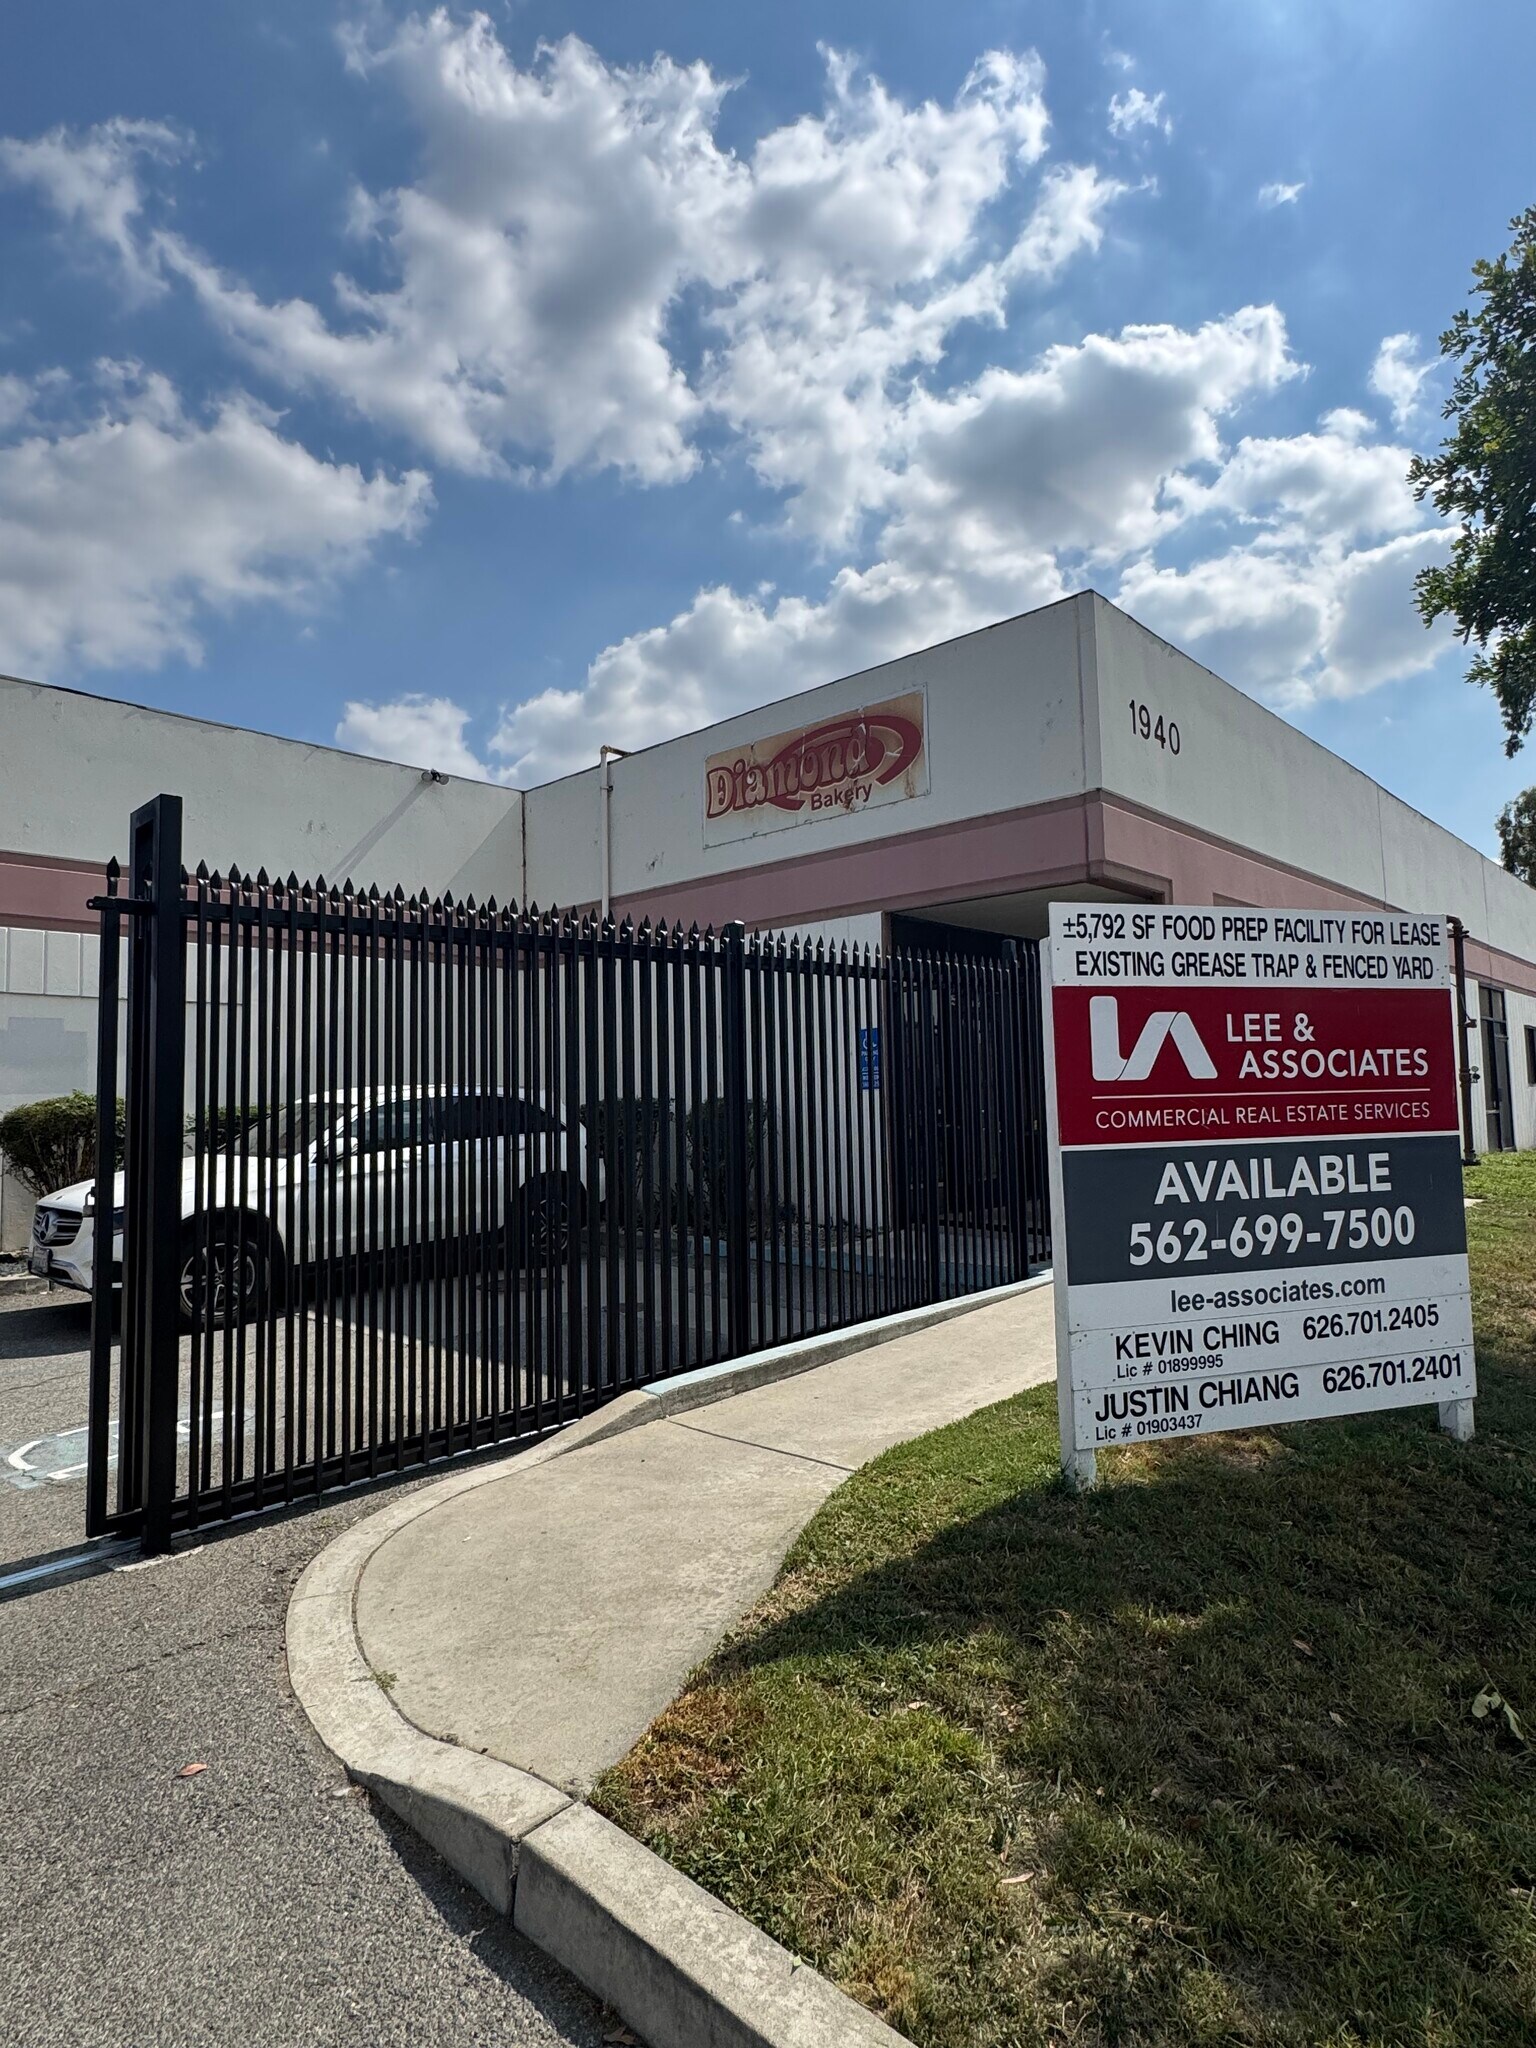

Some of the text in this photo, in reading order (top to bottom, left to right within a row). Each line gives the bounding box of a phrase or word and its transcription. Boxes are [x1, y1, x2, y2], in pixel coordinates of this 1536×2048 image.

[1129, 699, 1180, 755] 1940
[707, 723, 871, 818] Diamond
[811, 783, 872, 811] Bakery
[1063, 913, 1441, 946] ±5,792 SF FOOD PREP FACILITY FOR LEASE
[1075, 950, 1433, 980] EXISTING GREASE TRAP & FENCED YARD
[1226, 1013, 1316, 1043] LEE &
[1239, 1048, 1429, 1079] ASSOCIATES
[1096, 1101, 1431, 1129] COMMERCIAL REAL ESTATE SERVICES
[1154, 1152, 1392, 1205] AVAILABLE
[1129, 1205, 1415, 1266] 562-699-7500
[1170, 1277, 1386, 1312] lee-associates.com
[1115, 1304, 1439, 1360] KEVIN CHING 626.701.2405
[1117, 1354, 1223, 1378] Lic # 01899995
[1095, 1353, 1461, 1422] JUSTIN CHIANG 626.701.2401
[1096, 1414, 1203, 1441] Lic # 01903437
